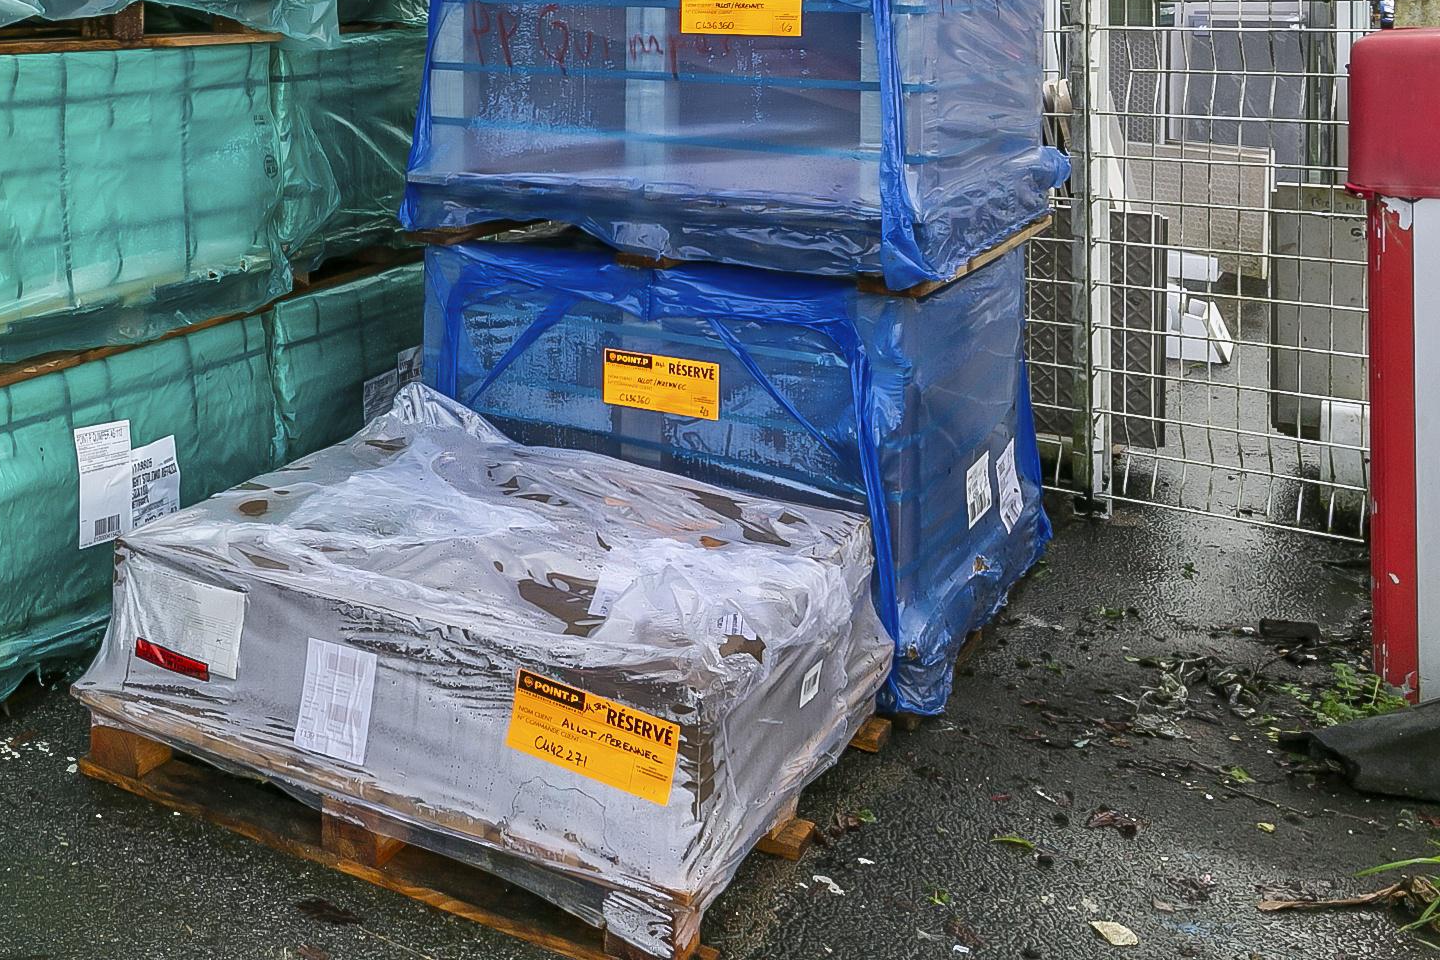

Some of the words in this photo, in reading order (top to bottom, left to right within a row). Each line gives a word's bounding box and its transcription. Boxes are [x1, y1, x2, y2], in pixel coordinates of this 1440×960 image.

[616, 354, 649, 366] POINT.P
[668, 361, 715, 381] RÉSERVÉ
[534, 680, 579, 703] POINT.P
[606, 708, 674, 747] RÉSERVÉ
